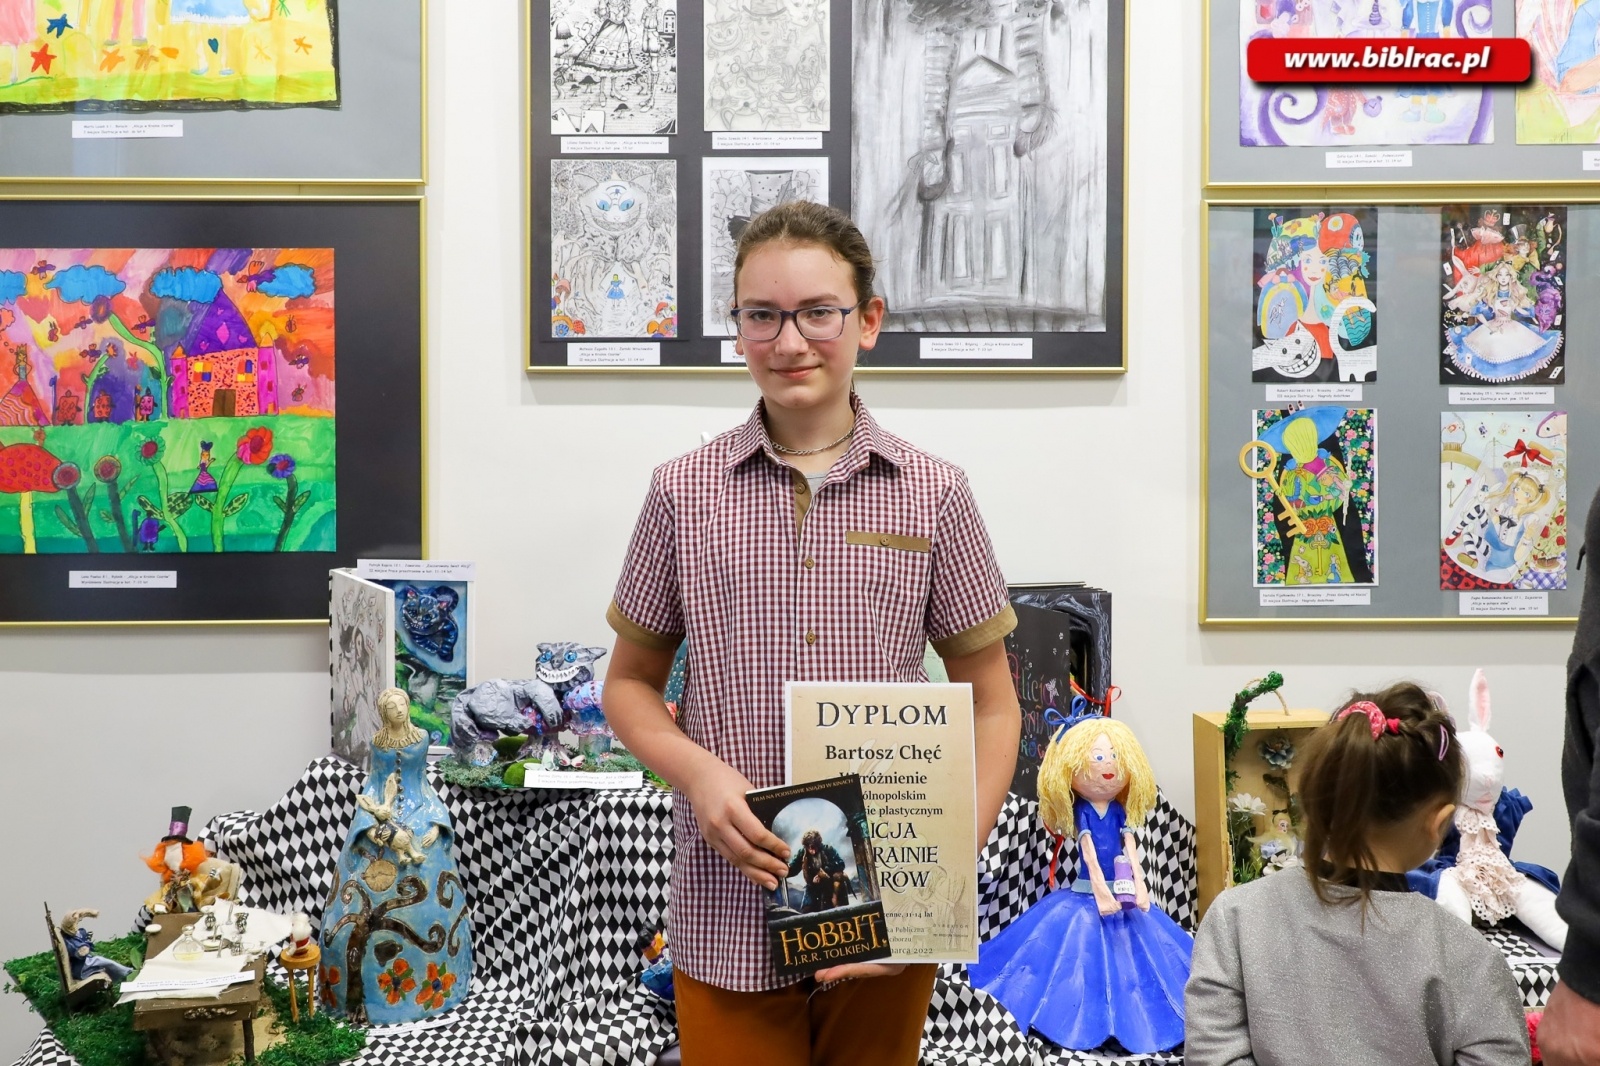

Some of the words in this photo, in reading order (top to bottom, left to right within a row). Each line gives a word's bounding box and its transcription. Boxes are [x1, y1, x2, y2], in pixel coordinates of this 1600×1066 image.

[816, 701, 948, 727] DYPLOM
[825, 745, 894, 760] Bartosz
[899, 744, 942, 763] Chęć
[839, 771, 928, 784] różnienie
[775, 788, 805, 798] PODSTAWIE
[862, 790, 926, 802] ólnopolskim
[879, 805, 943, 817] plastycznym
[870, 822, 918, 839] ICJA
[873, 845, 938, 869] RAINIE
[880, 867, 931, 893] RÓW
[794, 952, 822, 967] J.R.R.
[823, 942, 871, 960] TOLKIEN
